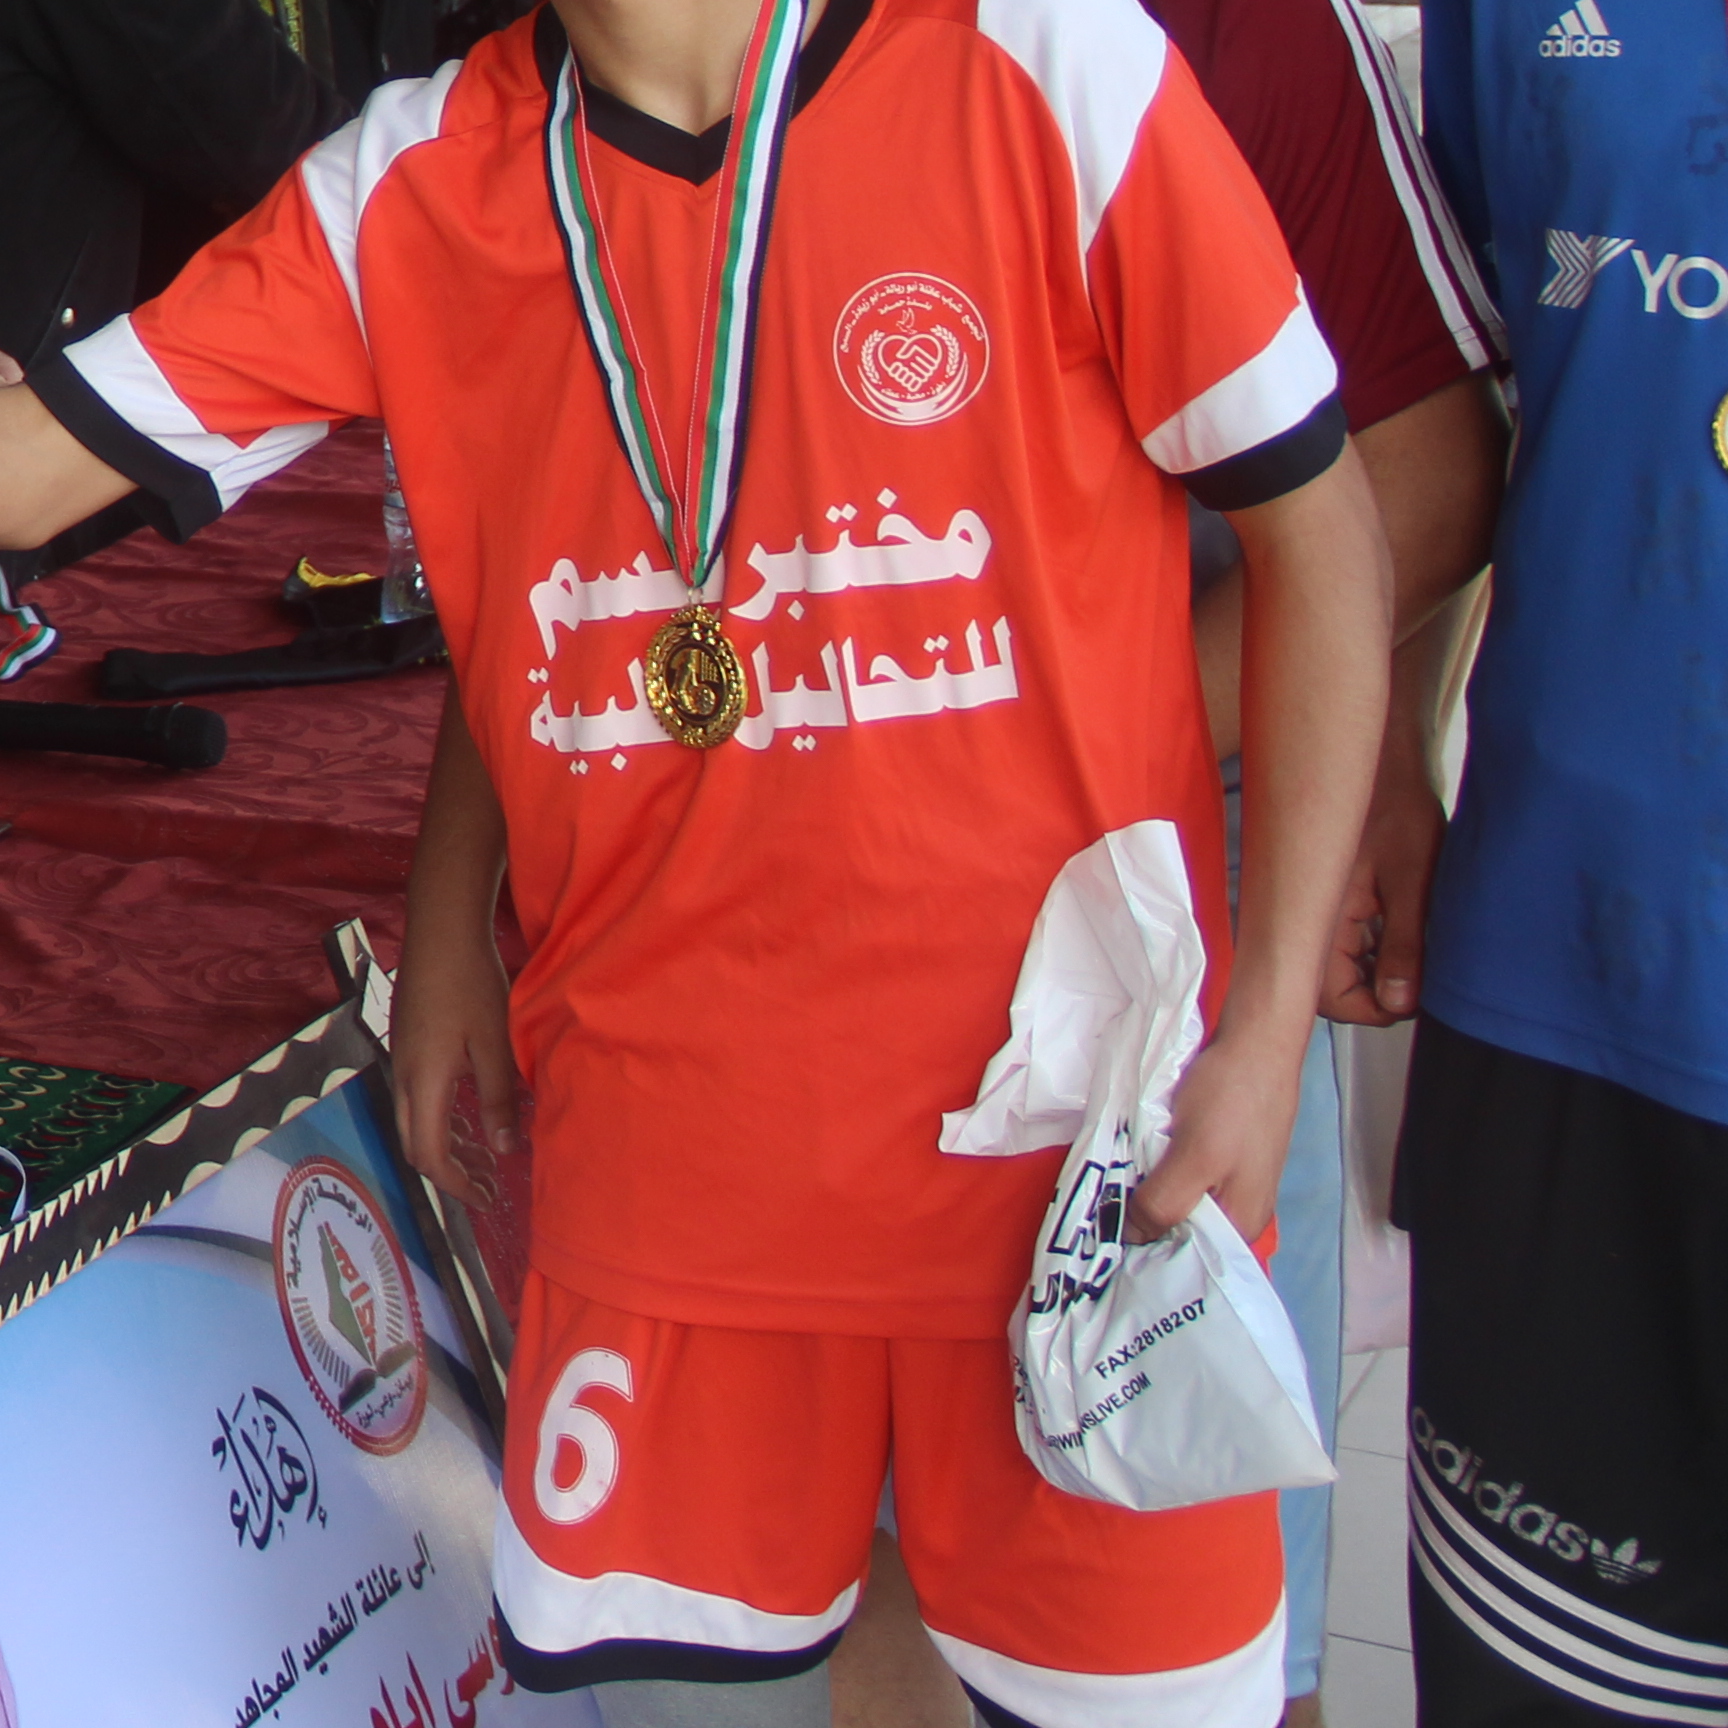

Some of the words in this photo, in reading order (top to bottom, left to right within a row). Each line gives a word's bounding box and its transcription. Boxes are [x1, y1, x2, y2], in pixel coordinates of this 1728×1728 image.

[1538, 35, 1622, 58] adidas
[728, 487, 992, 621] مختبر
[732, 616, 1019, 750] للتحاليل
[1095, 1298, 1207, 1379] FAX:2818207
[534, 1347, 634, 1525] 6
[1413, 1406, 1589, 1562] adidas
[302, 1591, 358, 1676] الشهيد
[355, 1564, 402, 1617] عائلة
